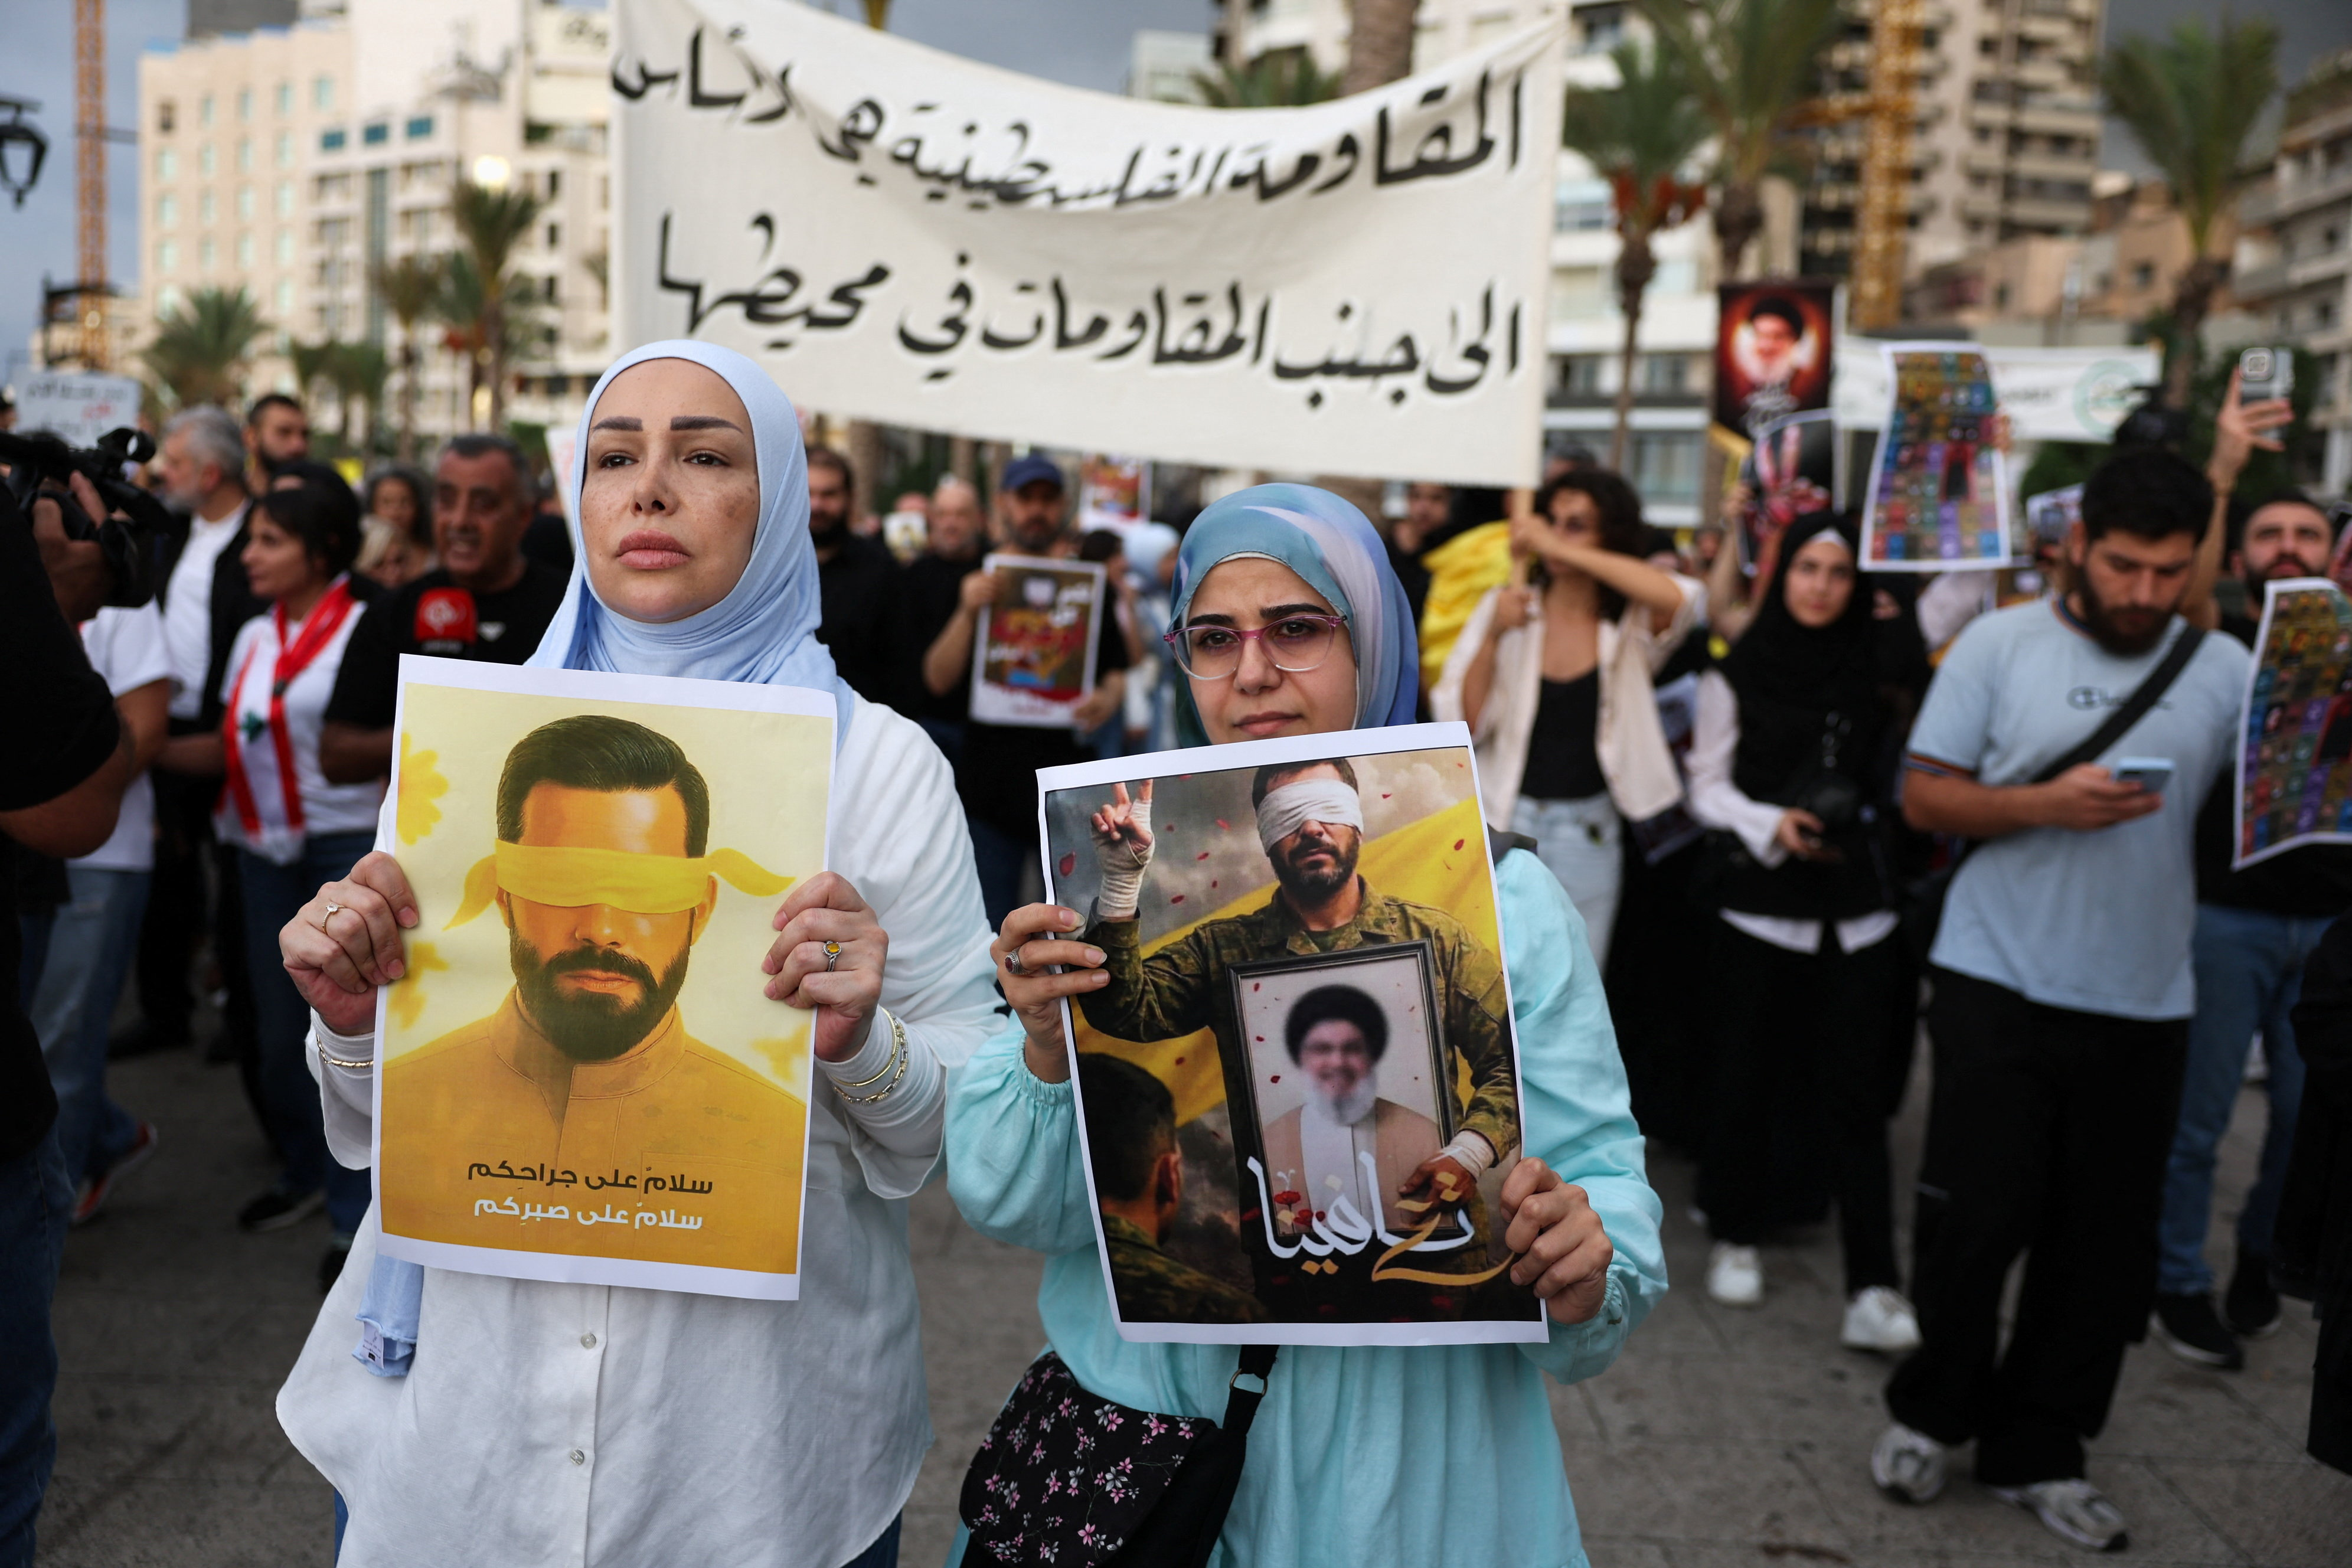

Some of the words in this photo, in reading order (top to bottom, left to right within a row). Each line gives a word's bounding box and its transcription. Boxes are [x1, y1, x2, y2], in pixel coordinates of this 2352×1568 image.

[1229, 65, 1522, 202] المقاومة
[660, 213, 891, 349] محيطها
[899, 251, 973, 384] في
[981, 274, 1270, 366] المقاومات
[577, 1204, 628, 1226] على
[584, 1169, 638, 1190] على
